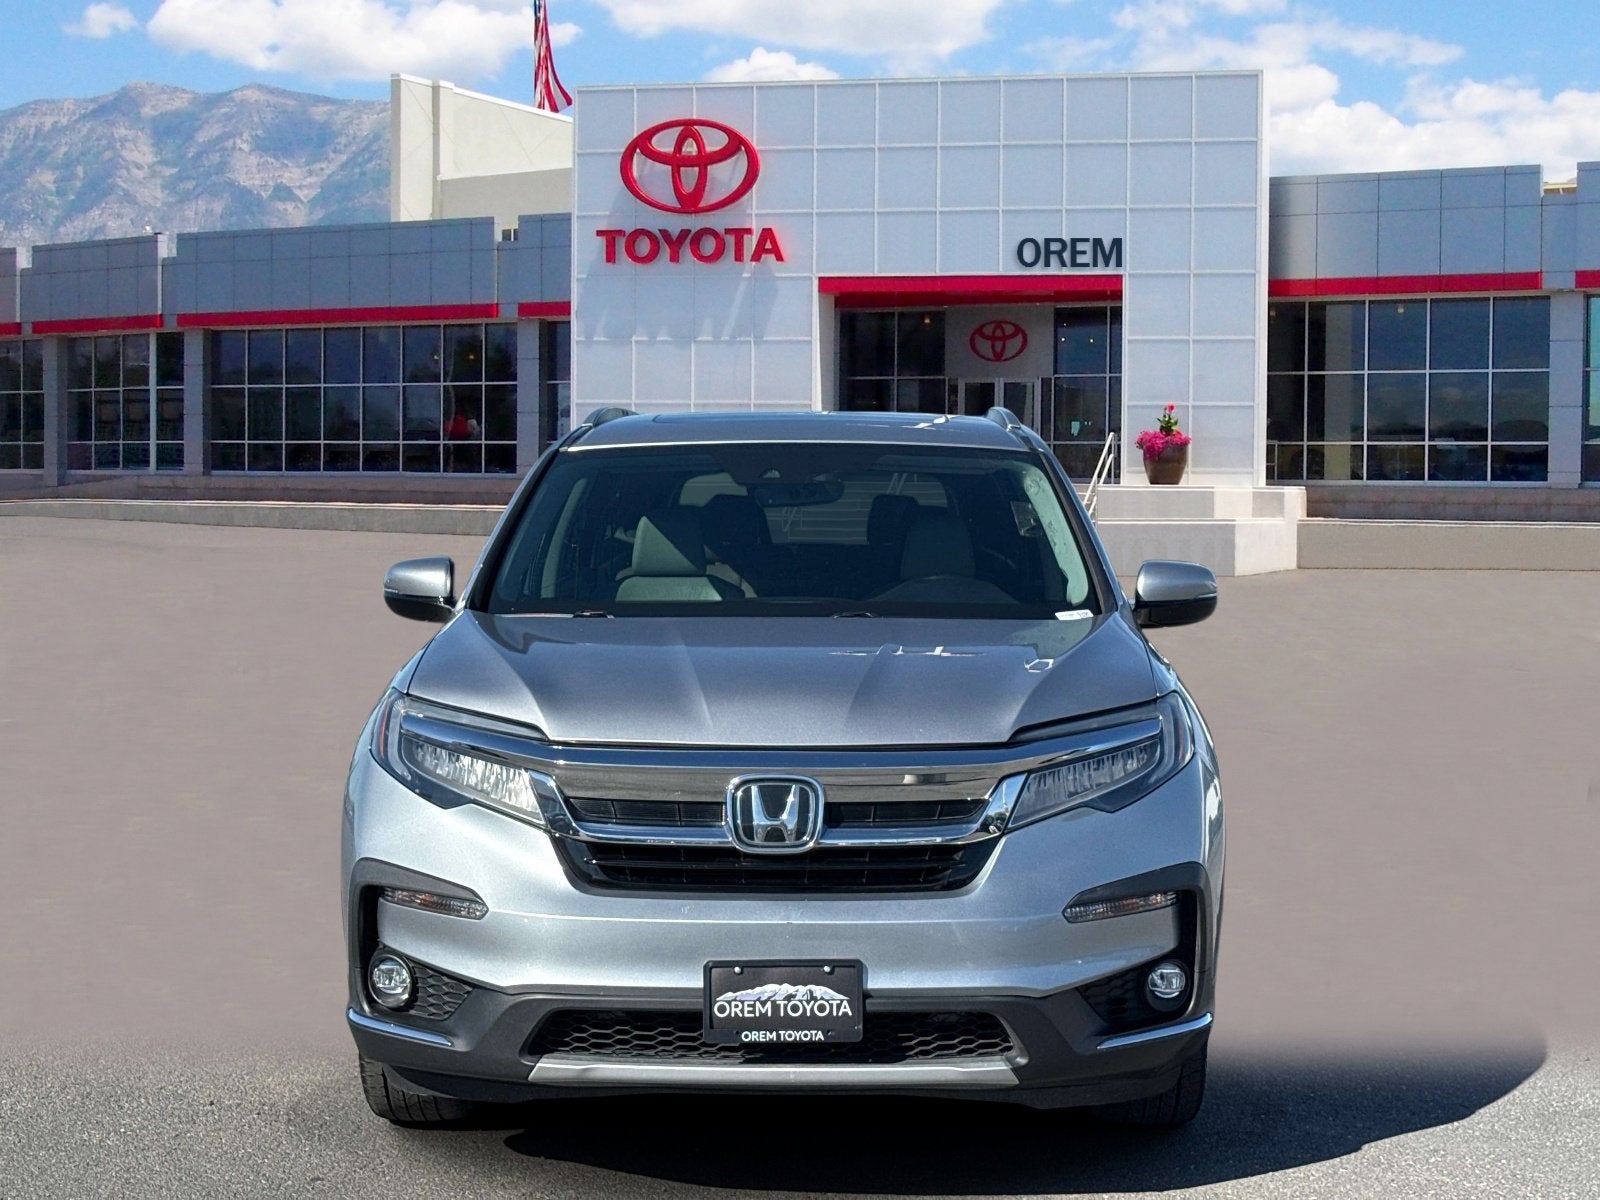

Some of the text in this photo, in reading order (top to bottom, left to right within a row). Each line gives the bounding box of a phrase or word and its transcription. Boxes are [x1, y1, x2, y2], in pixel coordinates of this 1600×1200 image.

[596, 227, 785, 265] TOYOTA
[1016, 237, 1123, 268] OREM
[713, 1000, 852, 1018] OREM TOYOTA
[741, 1030, 825, 1042] OREM TOYOTA
